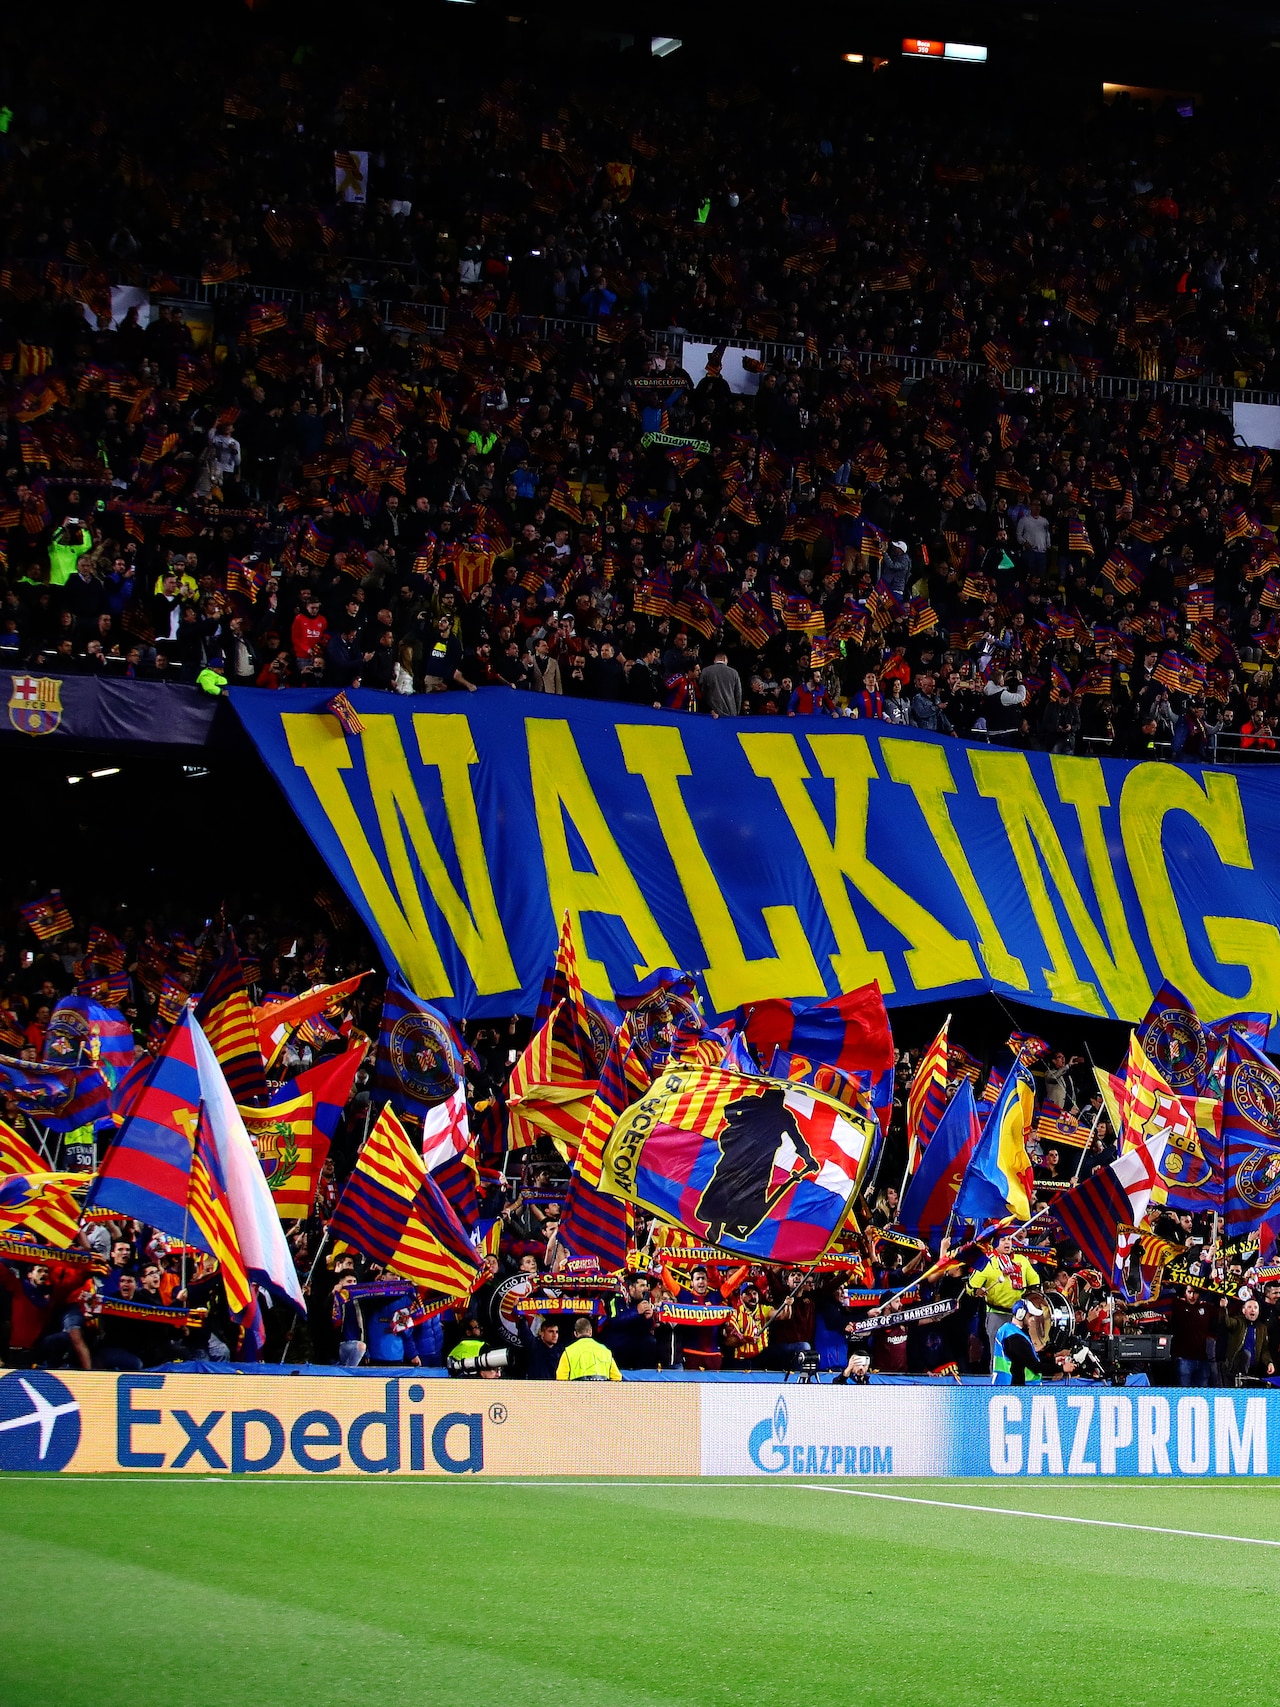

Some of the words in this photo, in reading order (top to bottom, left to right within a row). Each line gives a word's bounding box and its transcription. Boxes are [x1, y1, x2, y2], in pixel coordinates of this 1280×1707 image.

[1169, 1271, 1206, 1288] Front
[561, 1298, 594, 1311] JOHAN
[854, 1315, 879, 1330] SONS
[880, 1313, 893, 1325] OF
[904, 1301, 952, 1320] BARCELONA
[117, 1374, 485, 1474] Expedia
[988, 1395, 1267, 1476] GAZPROM
[792, 1446, 893, 1475] GAZPROM
